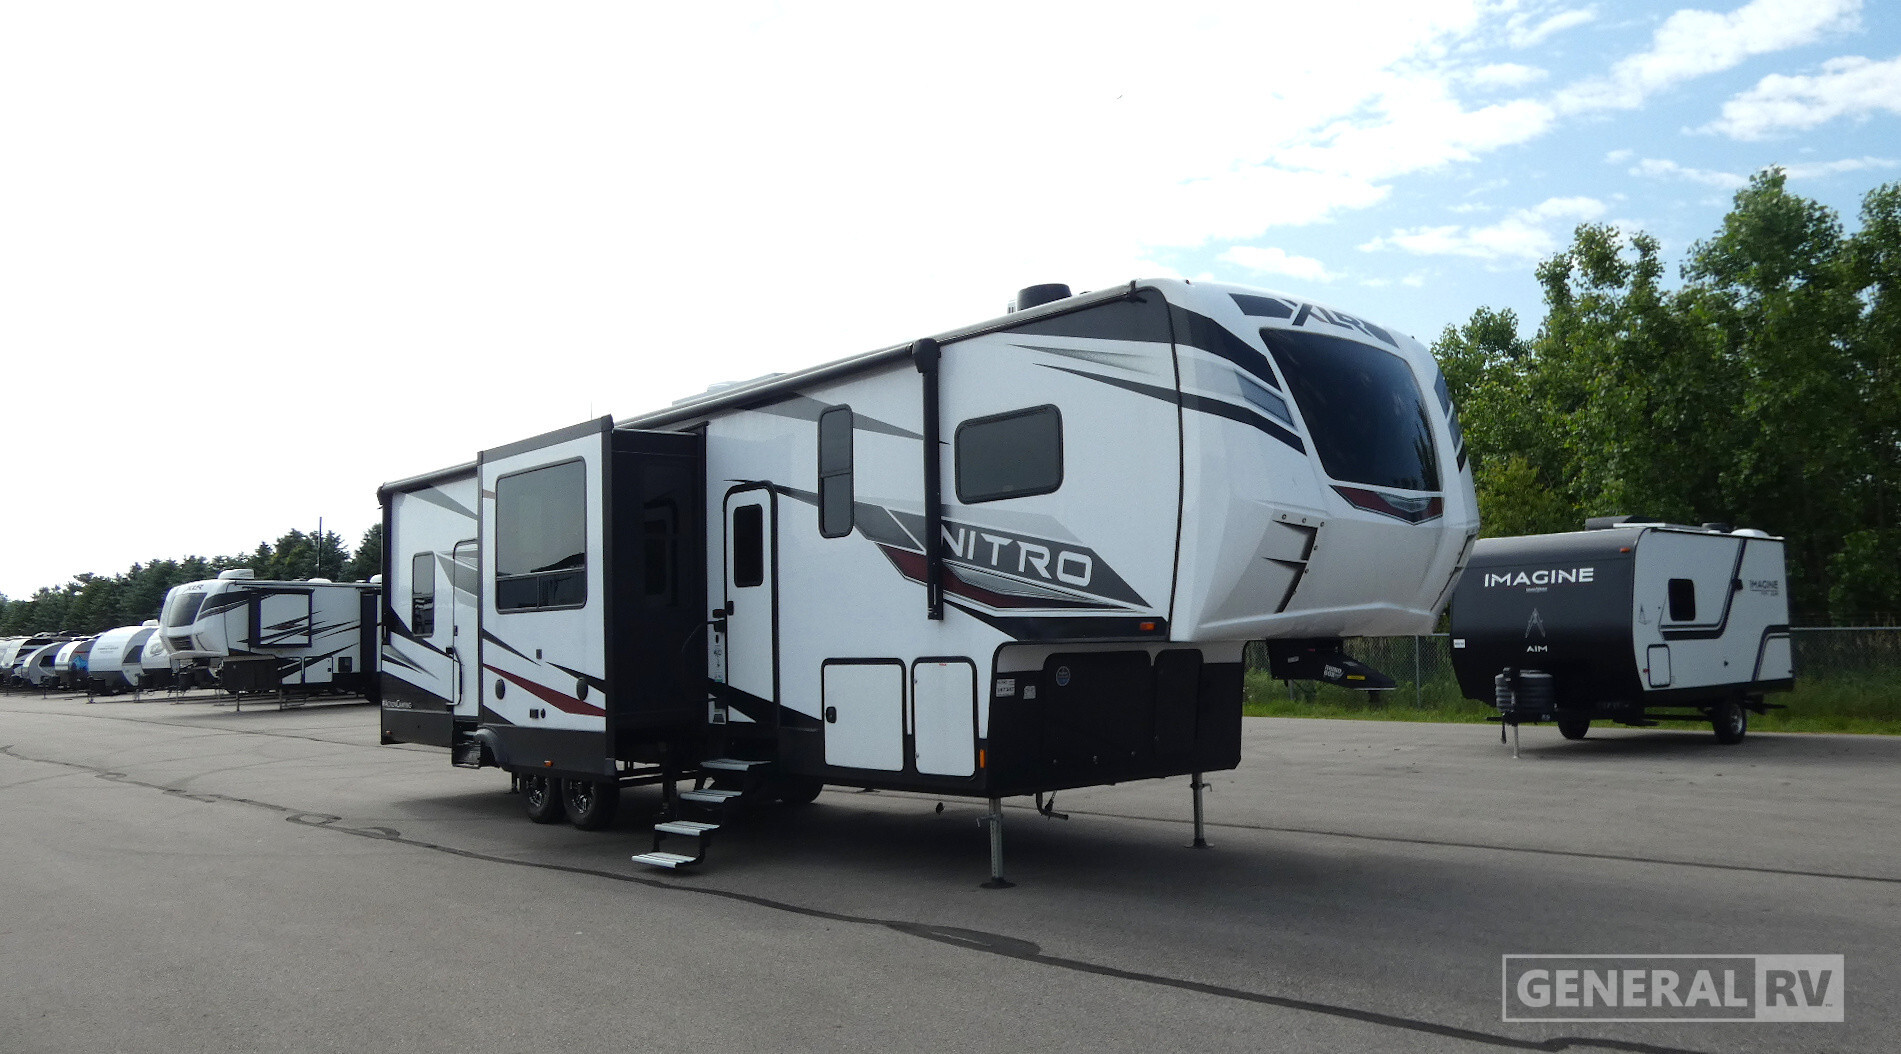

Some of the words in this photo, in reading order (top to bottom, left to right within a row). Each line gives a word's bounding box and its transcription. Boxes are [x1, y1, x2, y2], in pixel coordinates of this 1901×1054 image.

[1280, 299, 1373, 337] XLR
[941, 523, 1093, 587] NITRO
[1484, 567, 1594, 588] IMAGINE
[1526, 645, 1548, 653] AIM
